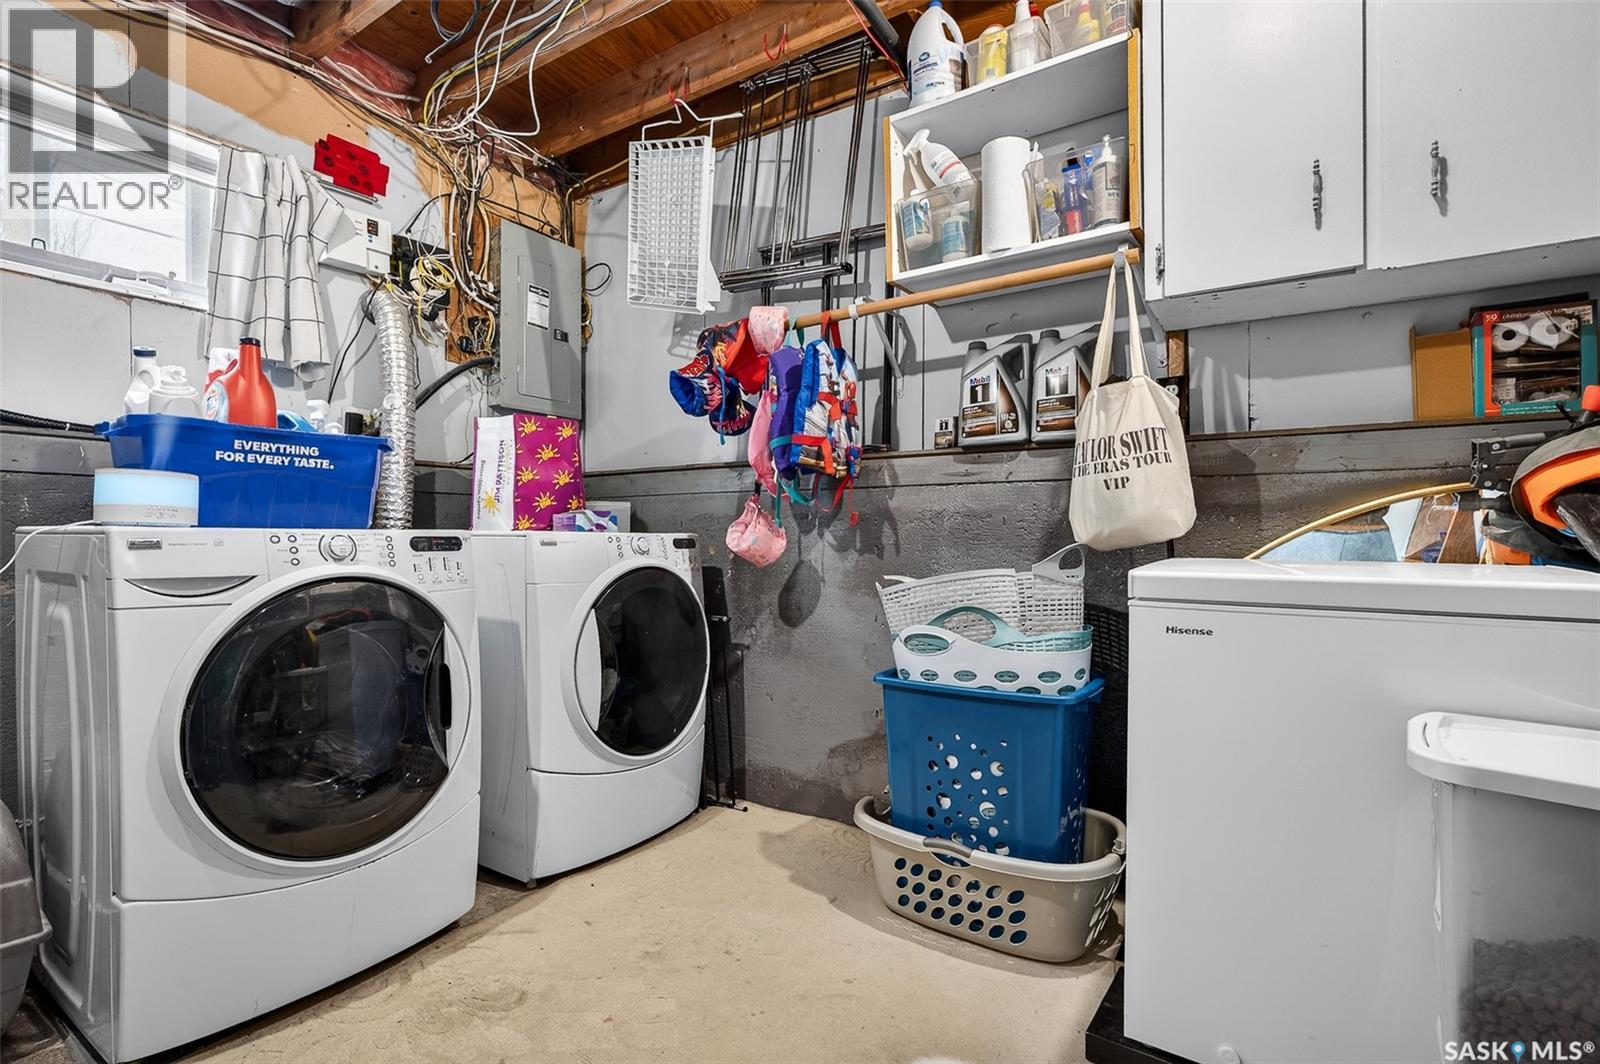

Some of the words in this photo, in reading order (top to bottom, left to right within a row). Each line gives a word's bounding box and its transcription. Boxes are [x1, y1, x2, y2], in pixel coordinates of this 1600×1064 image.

[975, 385, 983, 402] 1
[233, 439, 320, 456] EVERYTHING
[1074, 435, 1118, 465] TAYLOR
[1119, 426, 1169, 458] SWIFT
[215, 450, 245, 463] FOR
[247, 453, 291, 466] EVERY
[293, 457, 335, 470] TASTE.
[1093, 457, 1131, 475] ERAS
[1132, 451, 1173, 468] TOUR
[1103, 476, 1131, 491] VIP
[1165, 625, 1214, 637] Hisense
